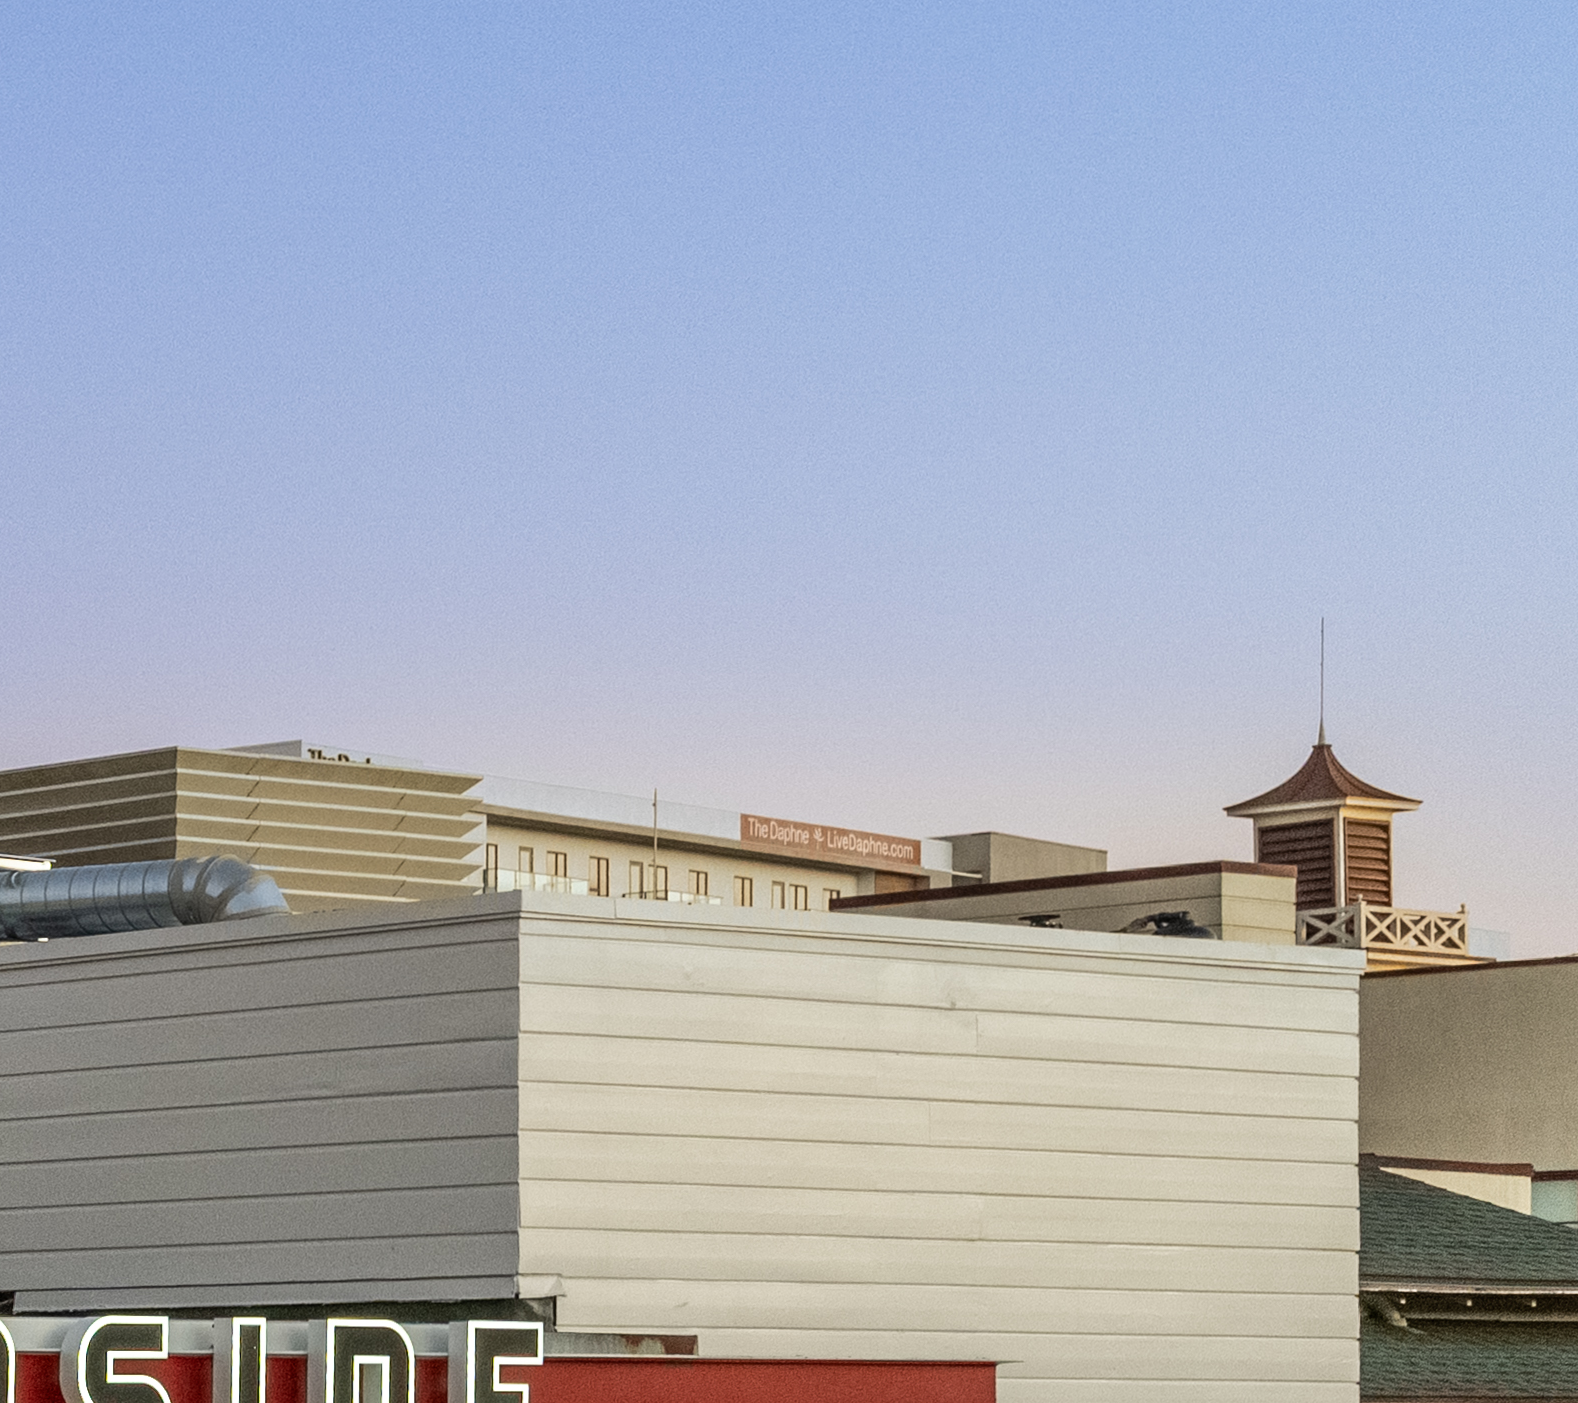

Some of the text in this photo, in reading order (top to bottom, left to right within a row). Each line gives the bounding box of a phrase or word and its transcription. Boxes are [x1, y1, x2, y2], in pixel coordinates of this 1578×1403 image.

[748, 817, 914, 860] The Daphne LiveDaphne.com
